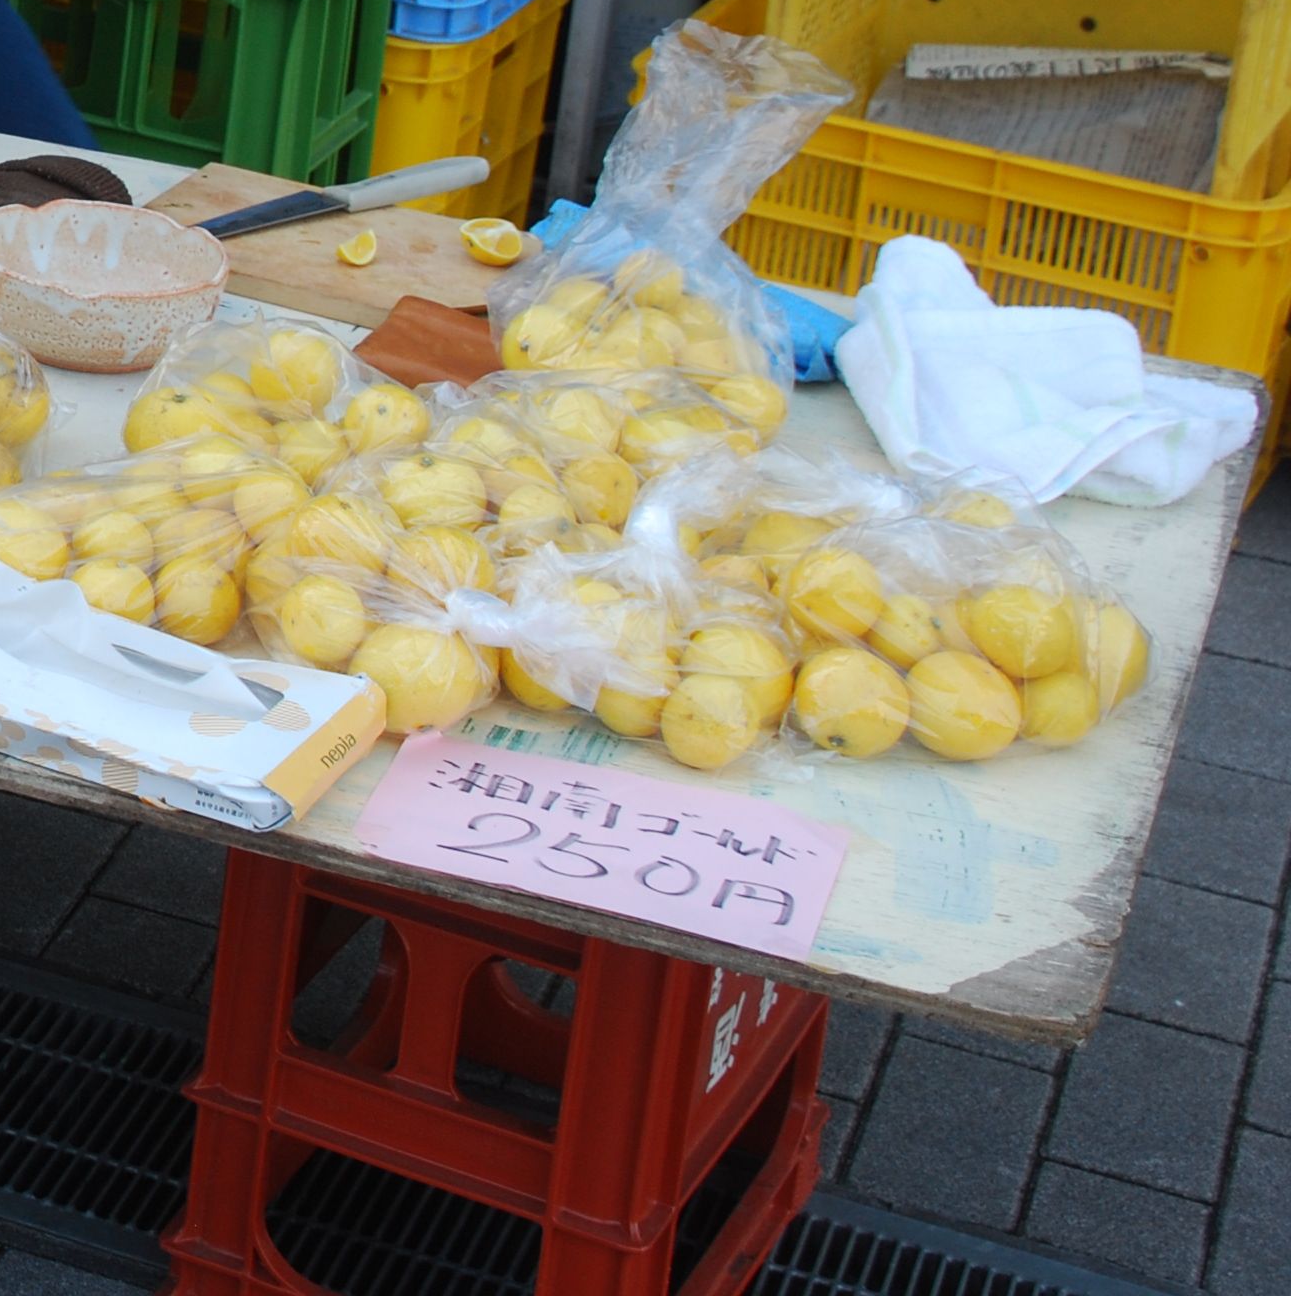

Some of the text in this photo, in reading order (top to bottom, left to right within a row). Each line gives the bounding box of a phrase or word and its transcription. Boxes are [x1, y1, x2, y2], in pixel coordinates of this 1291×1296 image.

[320, 731, 358, 770] nepia
[427, 758, 819, 866] 湘南ゴールド
[436, 811, 796, 927] 250円
